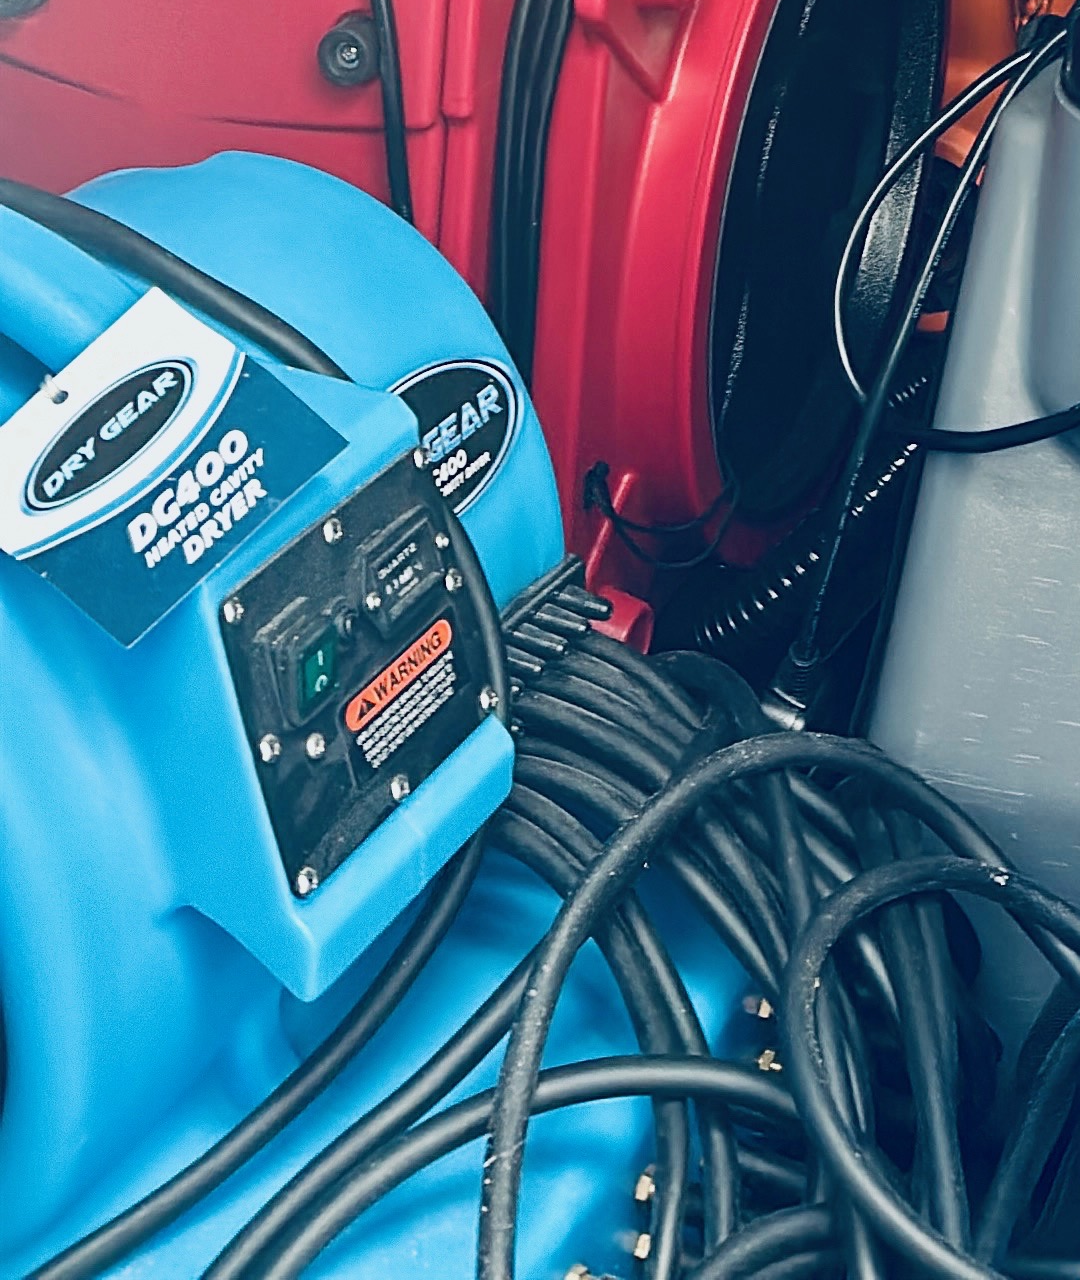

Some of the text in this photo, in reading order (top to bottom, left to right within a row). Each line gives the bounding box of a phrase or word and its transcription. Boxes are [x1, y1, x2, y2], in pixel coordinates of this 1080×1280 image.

[42, 370, 179, 499] DRY GEAR
[422, 384, 504, 463] GEAR
[127, 429, 249, 554] DG400
[143, 448, 265, 569] HEATED CAVITY
[432, 449, 468, 487] 400
[182, 479, 268, 565] DRYER
[373, 630, 443, 703] WARNING
